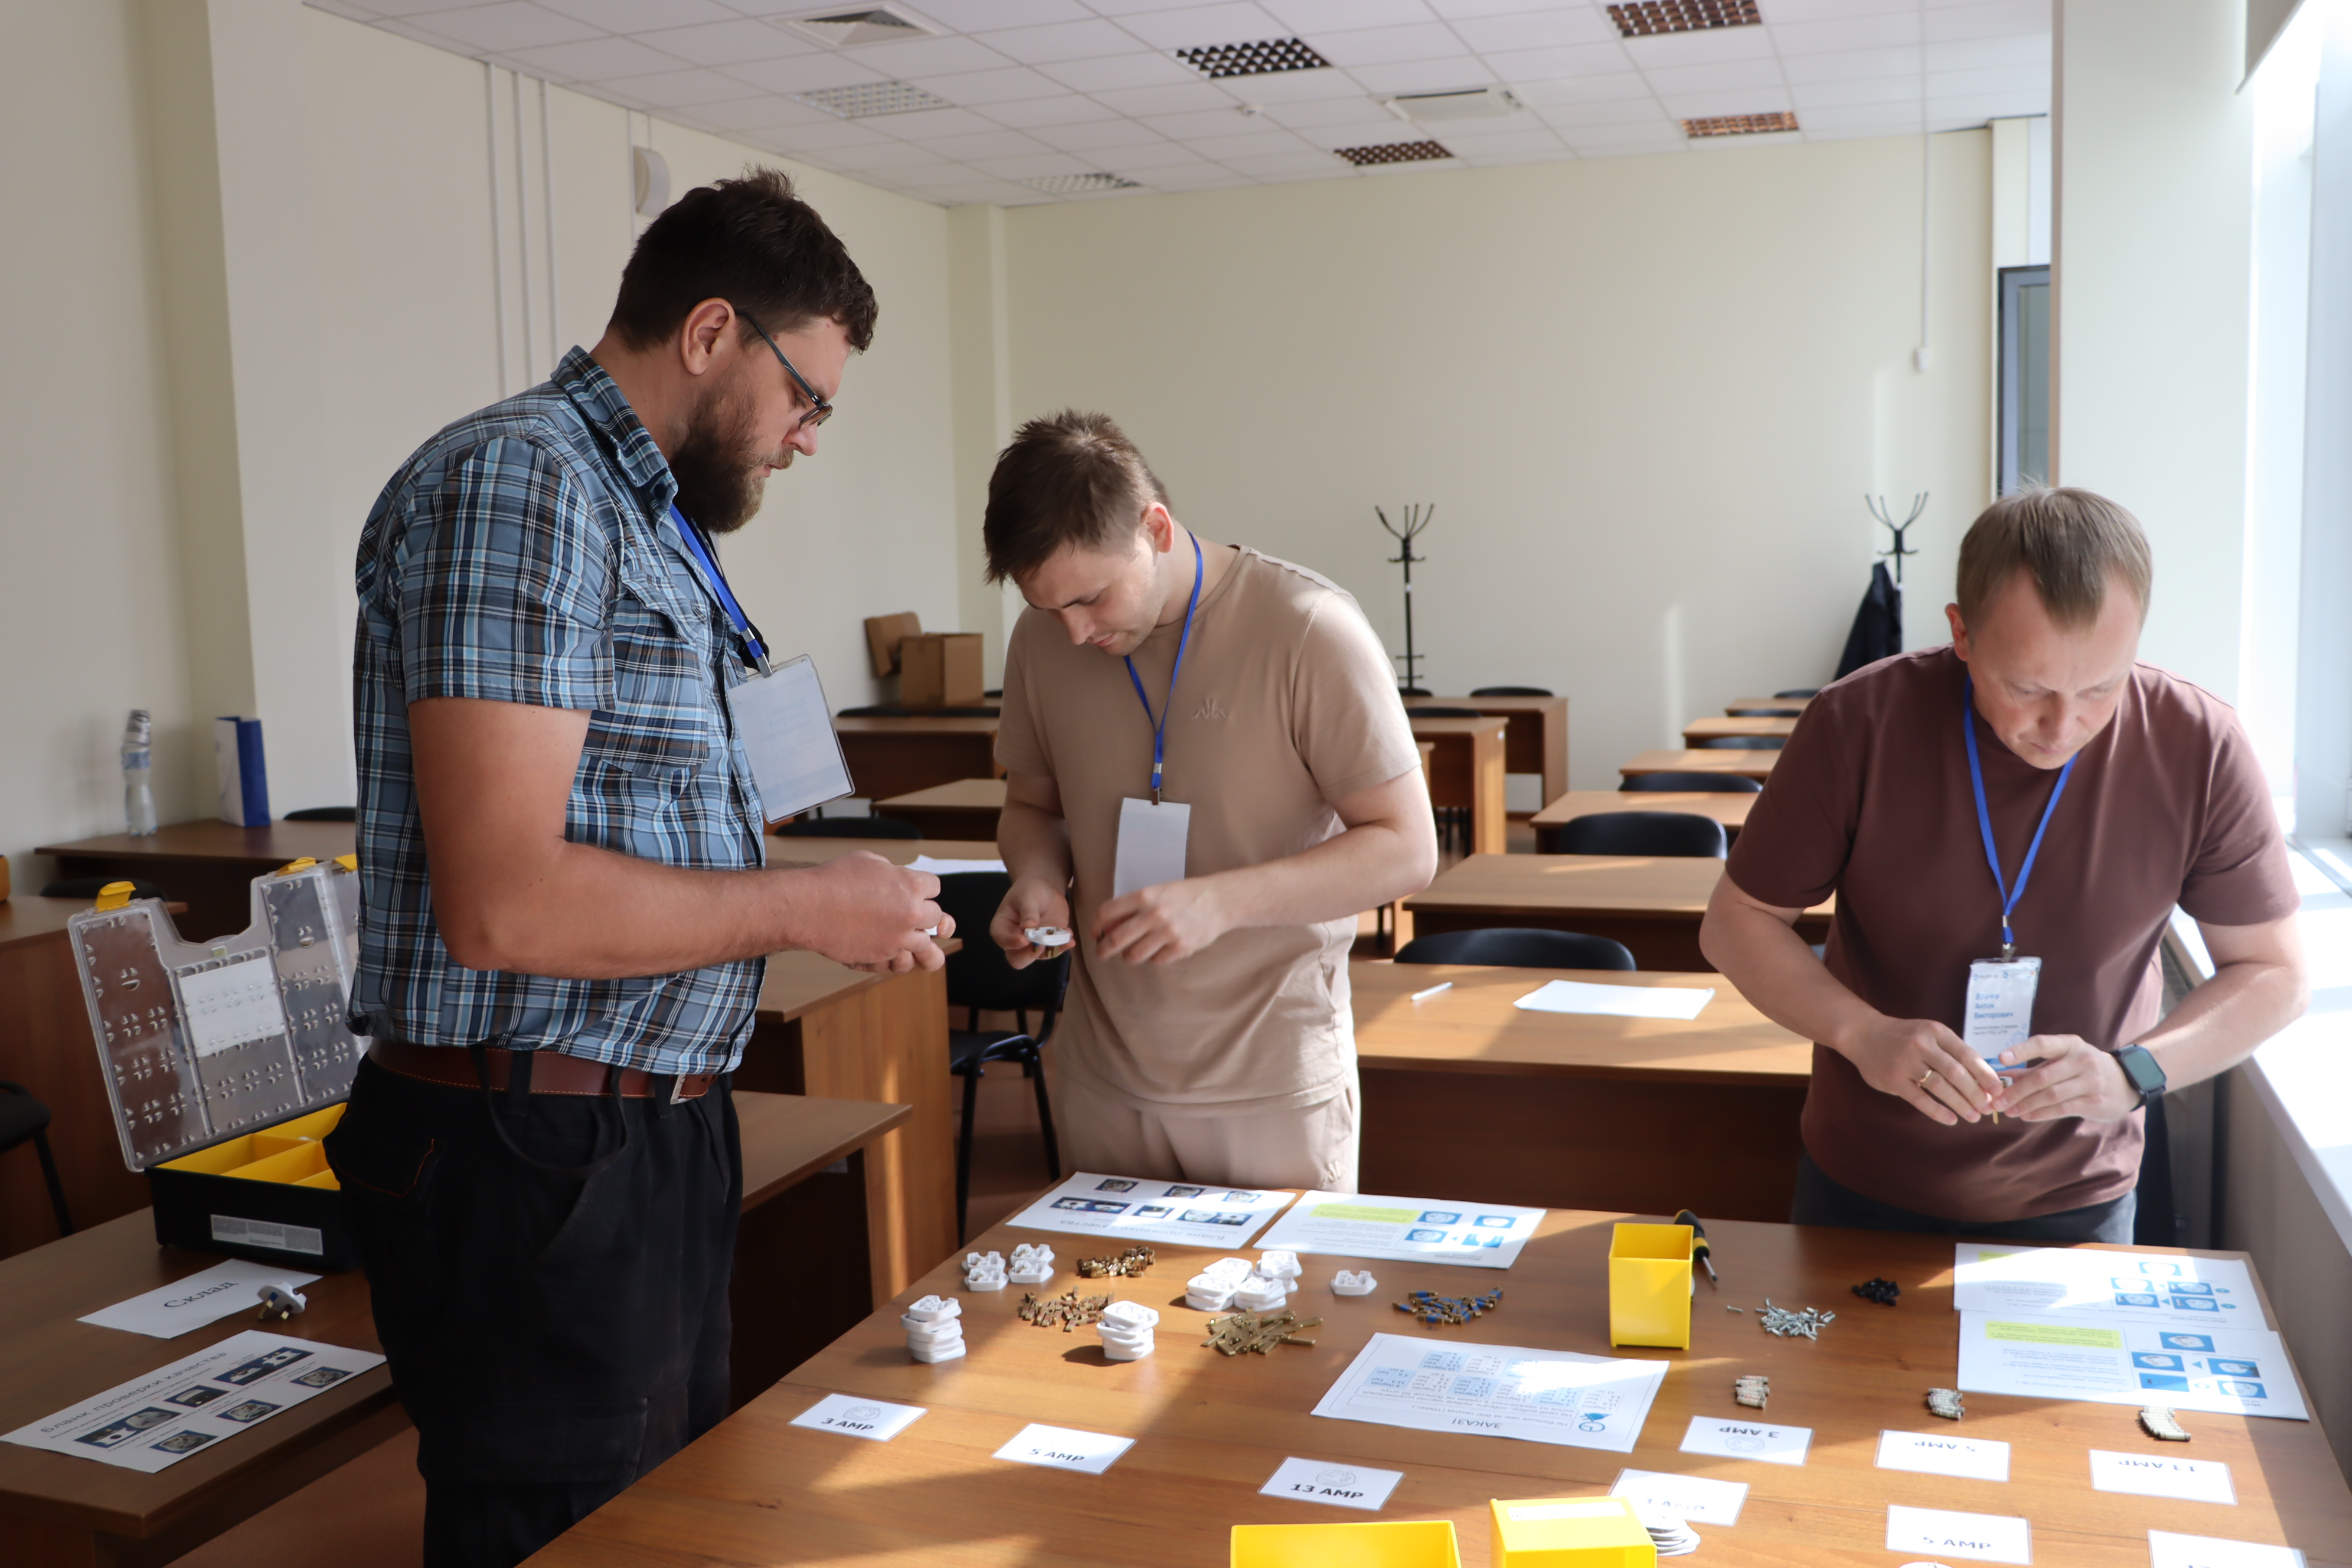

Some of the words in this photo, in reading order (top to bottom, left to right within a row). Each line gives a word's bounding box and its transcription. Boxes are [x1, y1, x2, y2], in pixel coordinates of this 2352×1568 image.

[164, 1282, 239, 1308] Склад
[40, 1411, 92, 1433] Бланк
[93, 1379, 164, 1411] проверки
[165, 1351, 228, 1380] качества
[835, 1420, 874, 1430] AMP
[1452, 1418, 1502, 1429] ЗАКАЗ!
[1523, 1417, 1555, 1426] больше
[1719, 1426, 1762, 1435] AMP
[1914, 1440, 1958, 1449] AMP
[1043, 1451, 1085, 1461] AMP
[2118, 1460, 2164, 1468] AMP
[1291, 1483, 1315, 1492] 13
[1318, 1487, 1364, 1498] AMP
[1943, 1539, 1991, 1549] AMP
